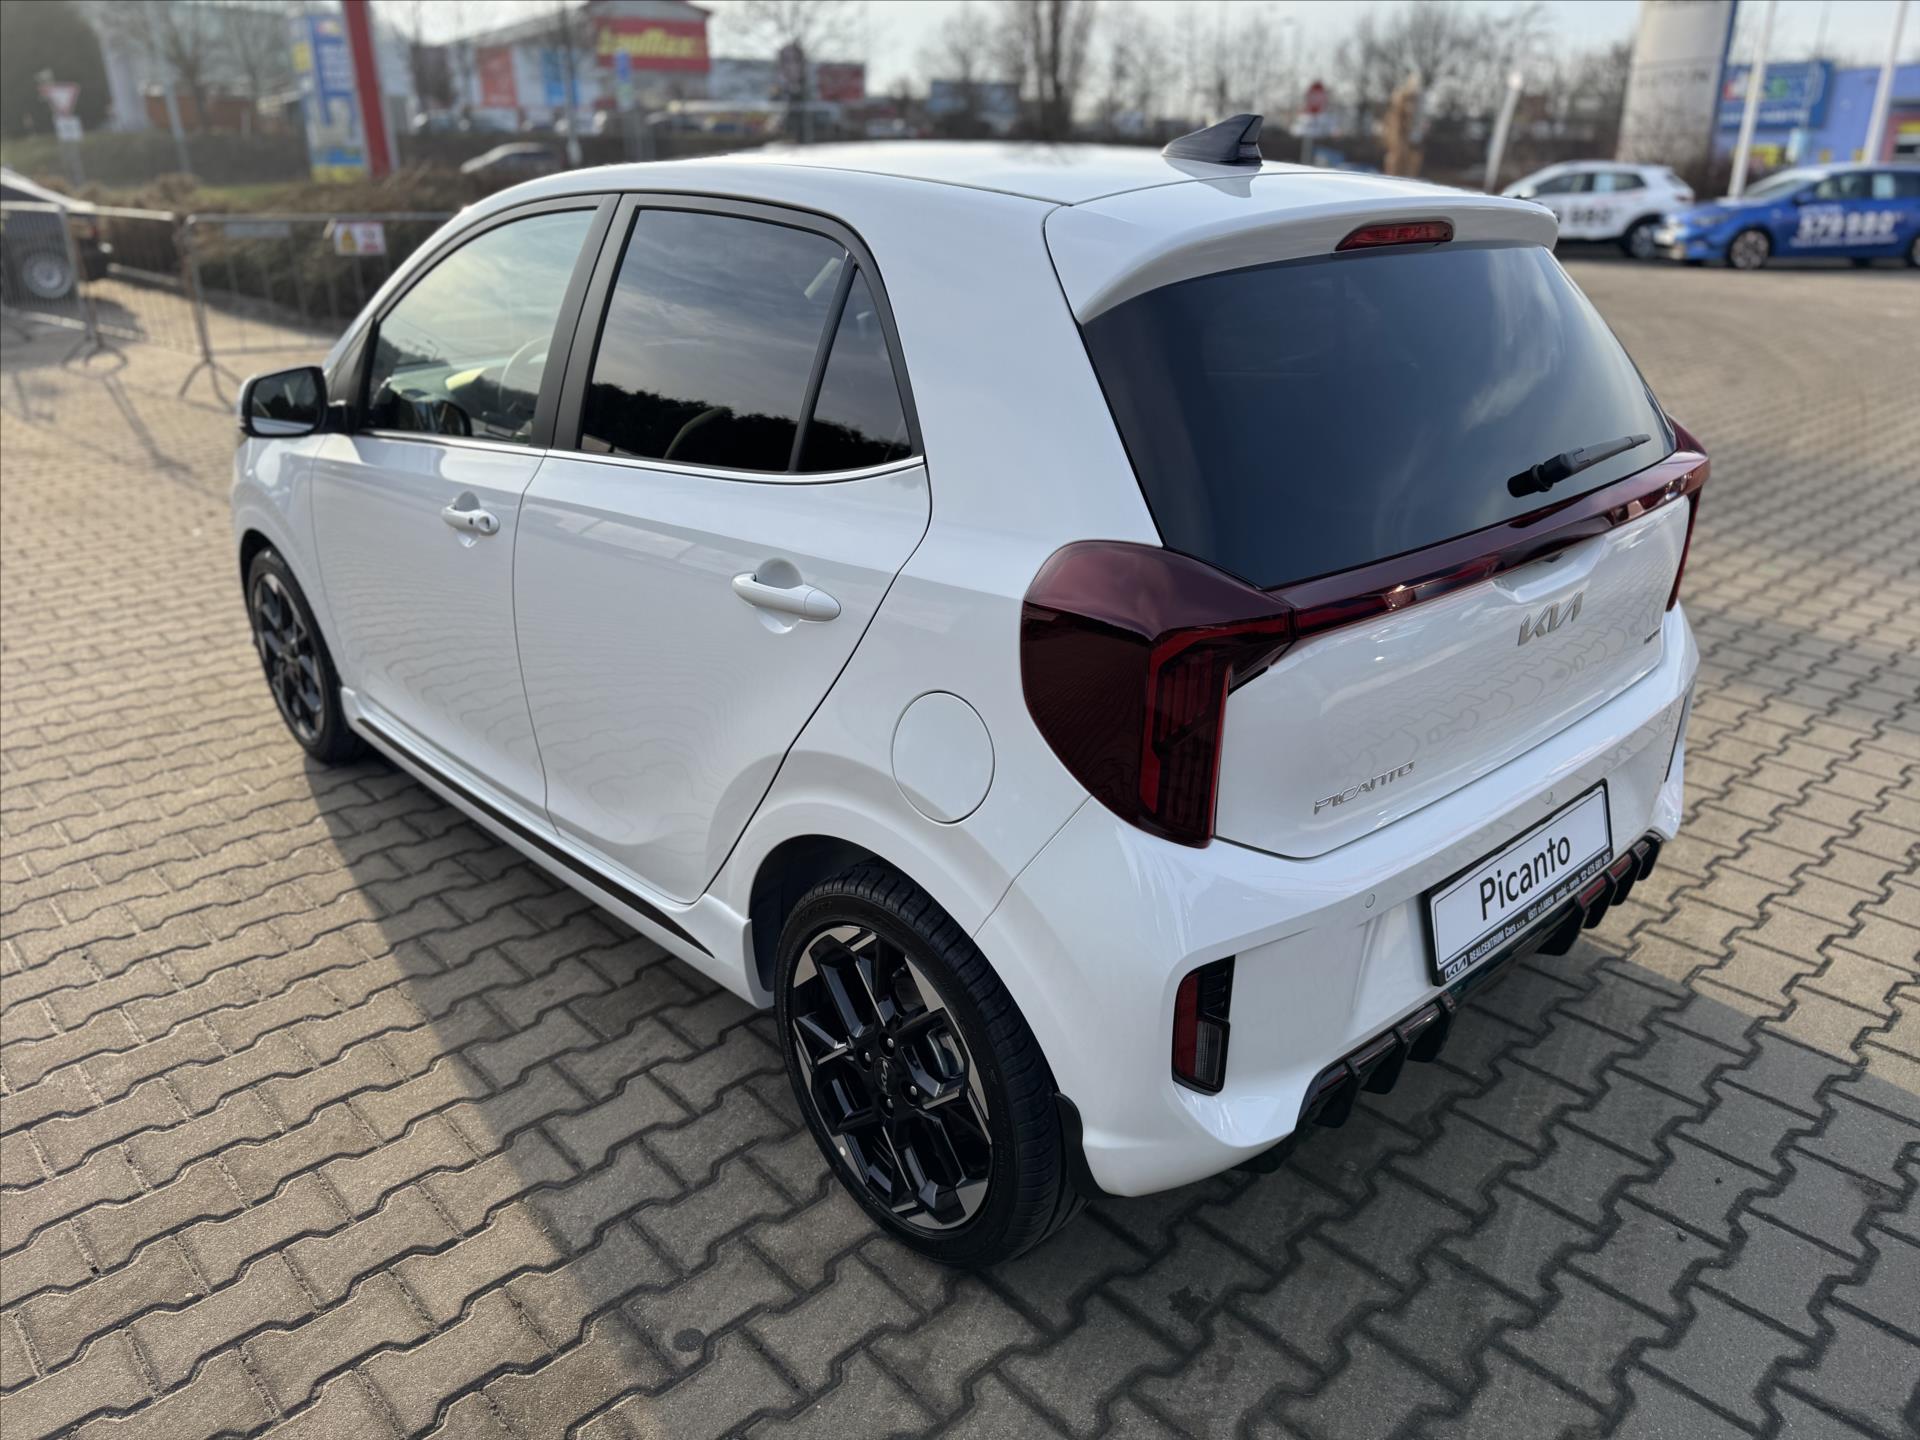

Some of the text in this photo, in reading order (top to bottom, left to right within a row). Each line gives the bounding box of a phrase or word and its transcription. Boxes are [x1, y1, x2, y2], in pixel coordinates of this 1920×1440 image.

[1517, 591, 1584, 647] KIA
[1313, 760, 1415, 815] PICANTO
[1479, 836, 1571, 921] Picanto
[1445, 956, 1467, 979] KIA
